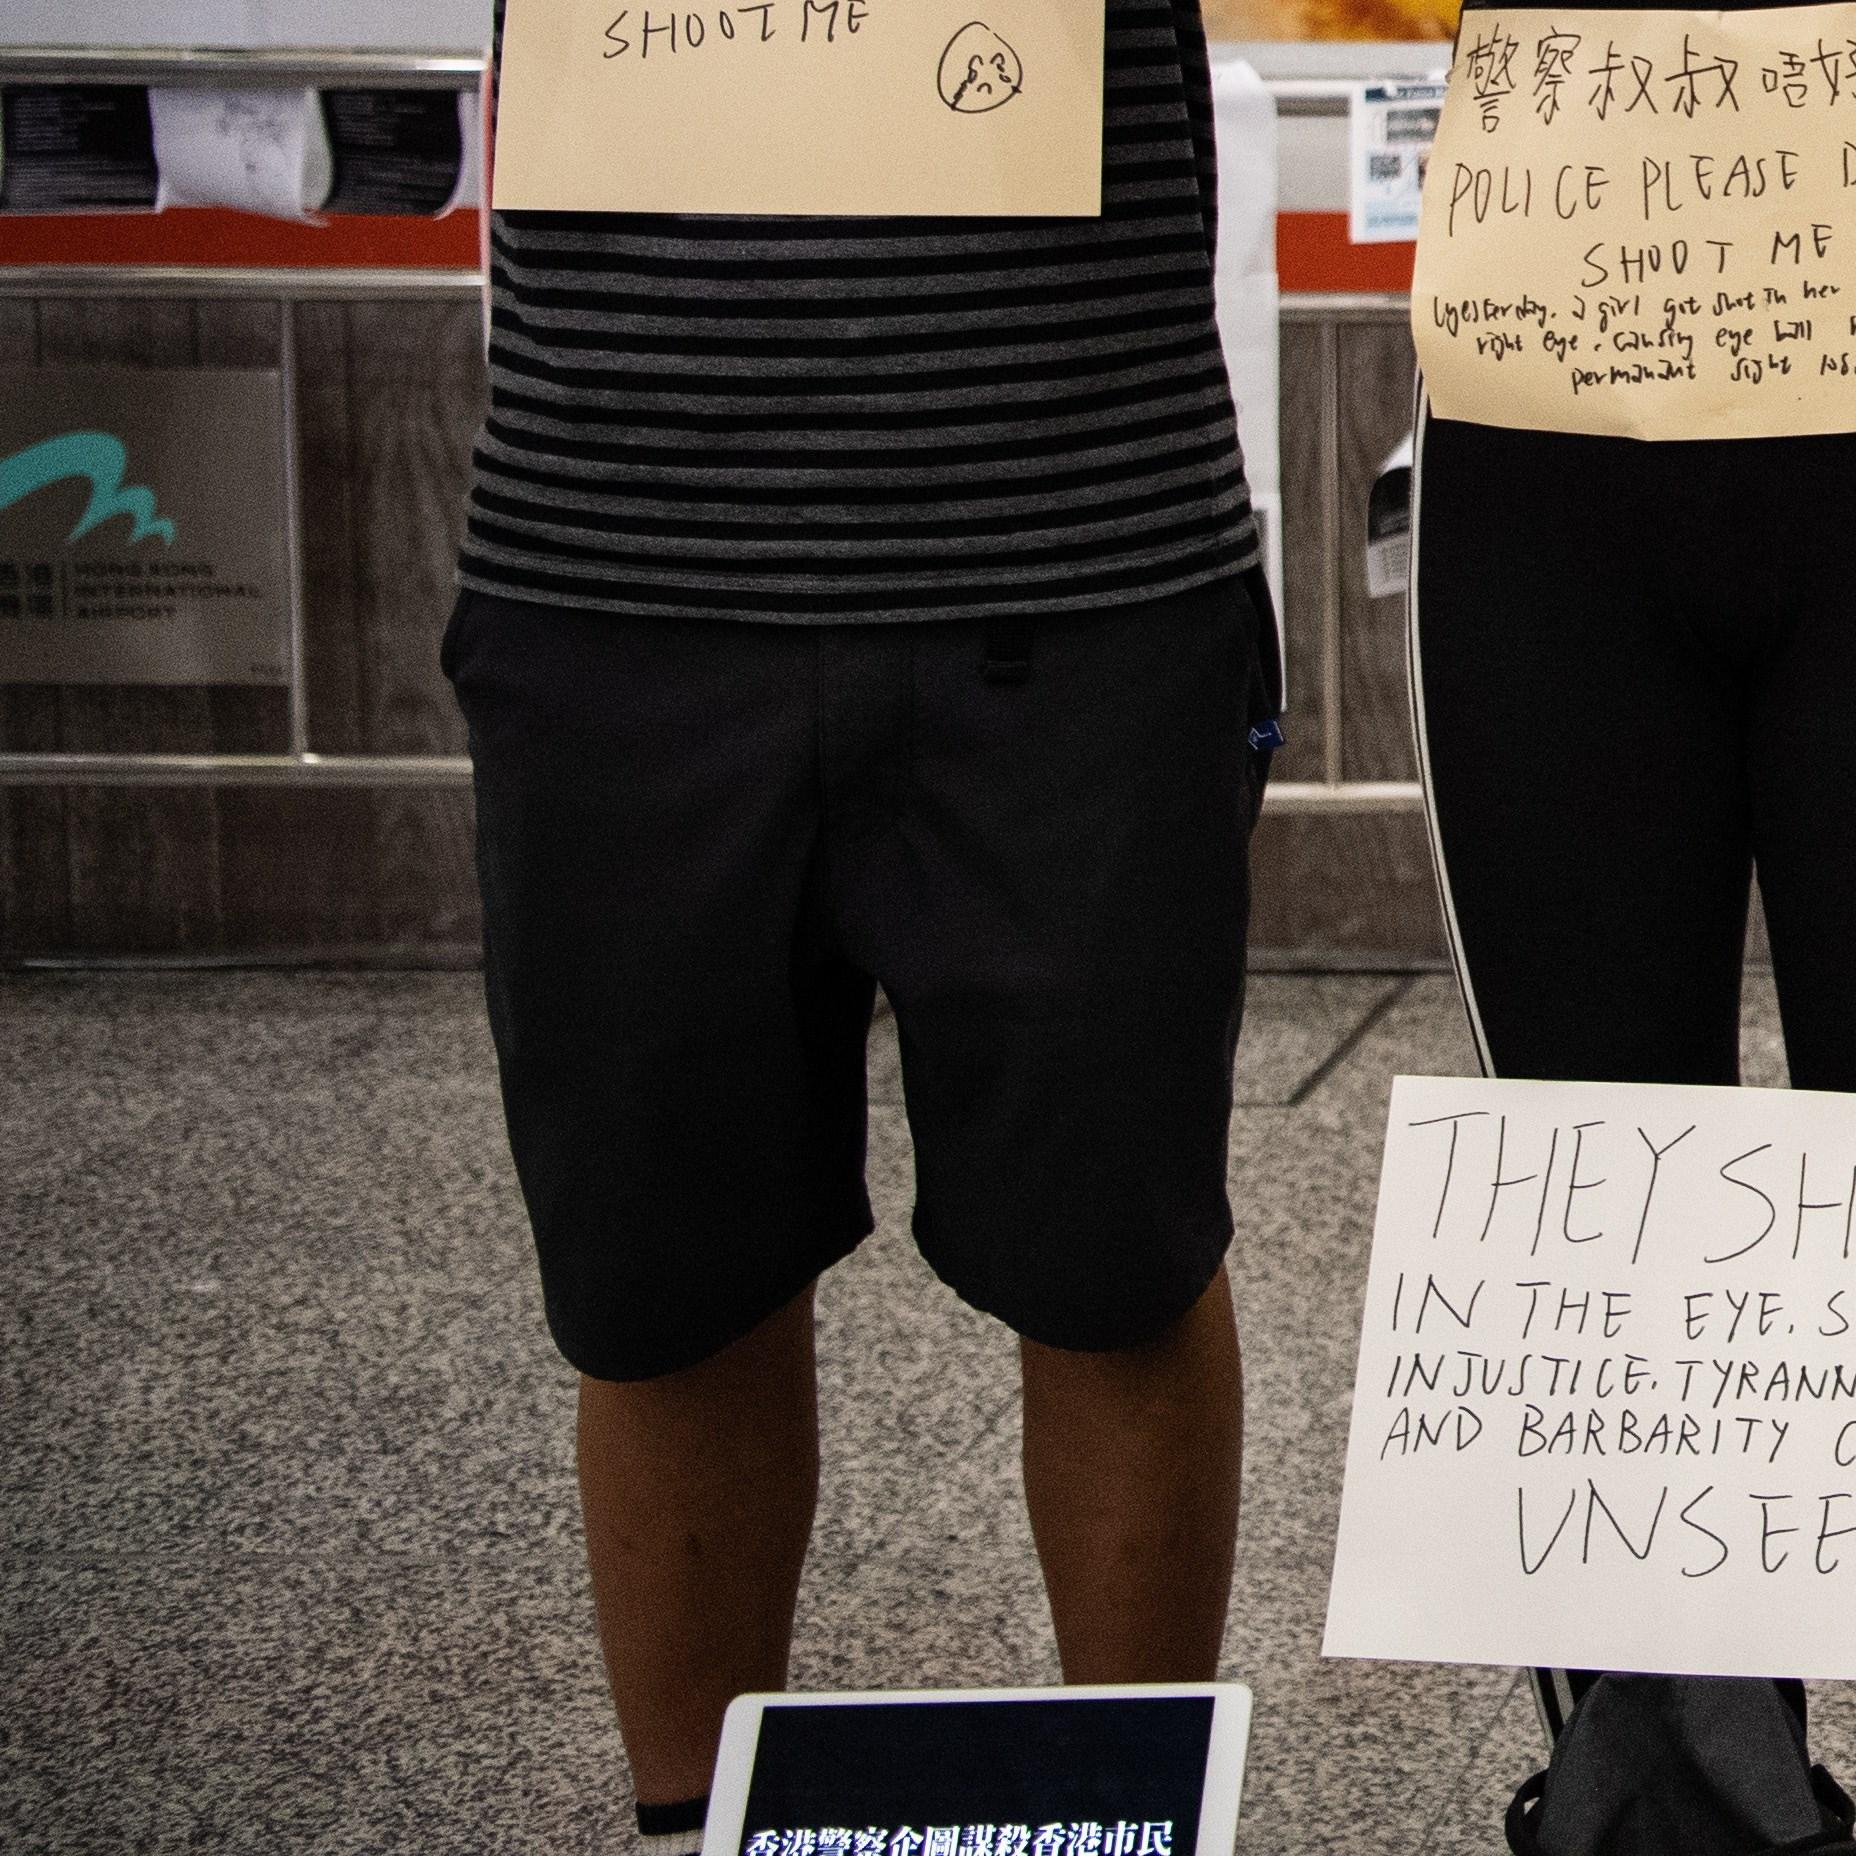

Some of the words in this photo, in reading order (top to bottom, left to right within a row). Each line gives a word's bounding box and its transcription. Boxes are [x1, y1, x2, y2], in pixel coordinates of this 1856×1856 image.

[604, 3, 776, 58] SHOOT
[1448, 162, 1610, 237] POLICE
[1642, 150, 1800, 219] PLEASE
[1582, 240, 1734, 288] SHOOT
[1772, 224, 1833, 265] ME
[1599, 295, 1639, 333] girl
[1664, 296, 1702, 328] got
[1713, 293, 1755, 316] shot
[1803, 280, 1840, 298] her
[1477, 332, 1523, 361] right
[1613, 328, 1694, 360] causing
[1715, 327, 1753, 356] eye
[1731, 354, 1791, 384] sight
[1408, 1110, 1698, 1266] THEY
[1393, 1273, 1485, 1333] IN
[1515, 1280, 1633, 1340] THE
[1380, 1404, 1484, 1461] AND
[1516, 1404, 1791, 1463] BARBARITY
[746, 1820, 1174, 1856] 香港警察企圖謀殺香港市民
